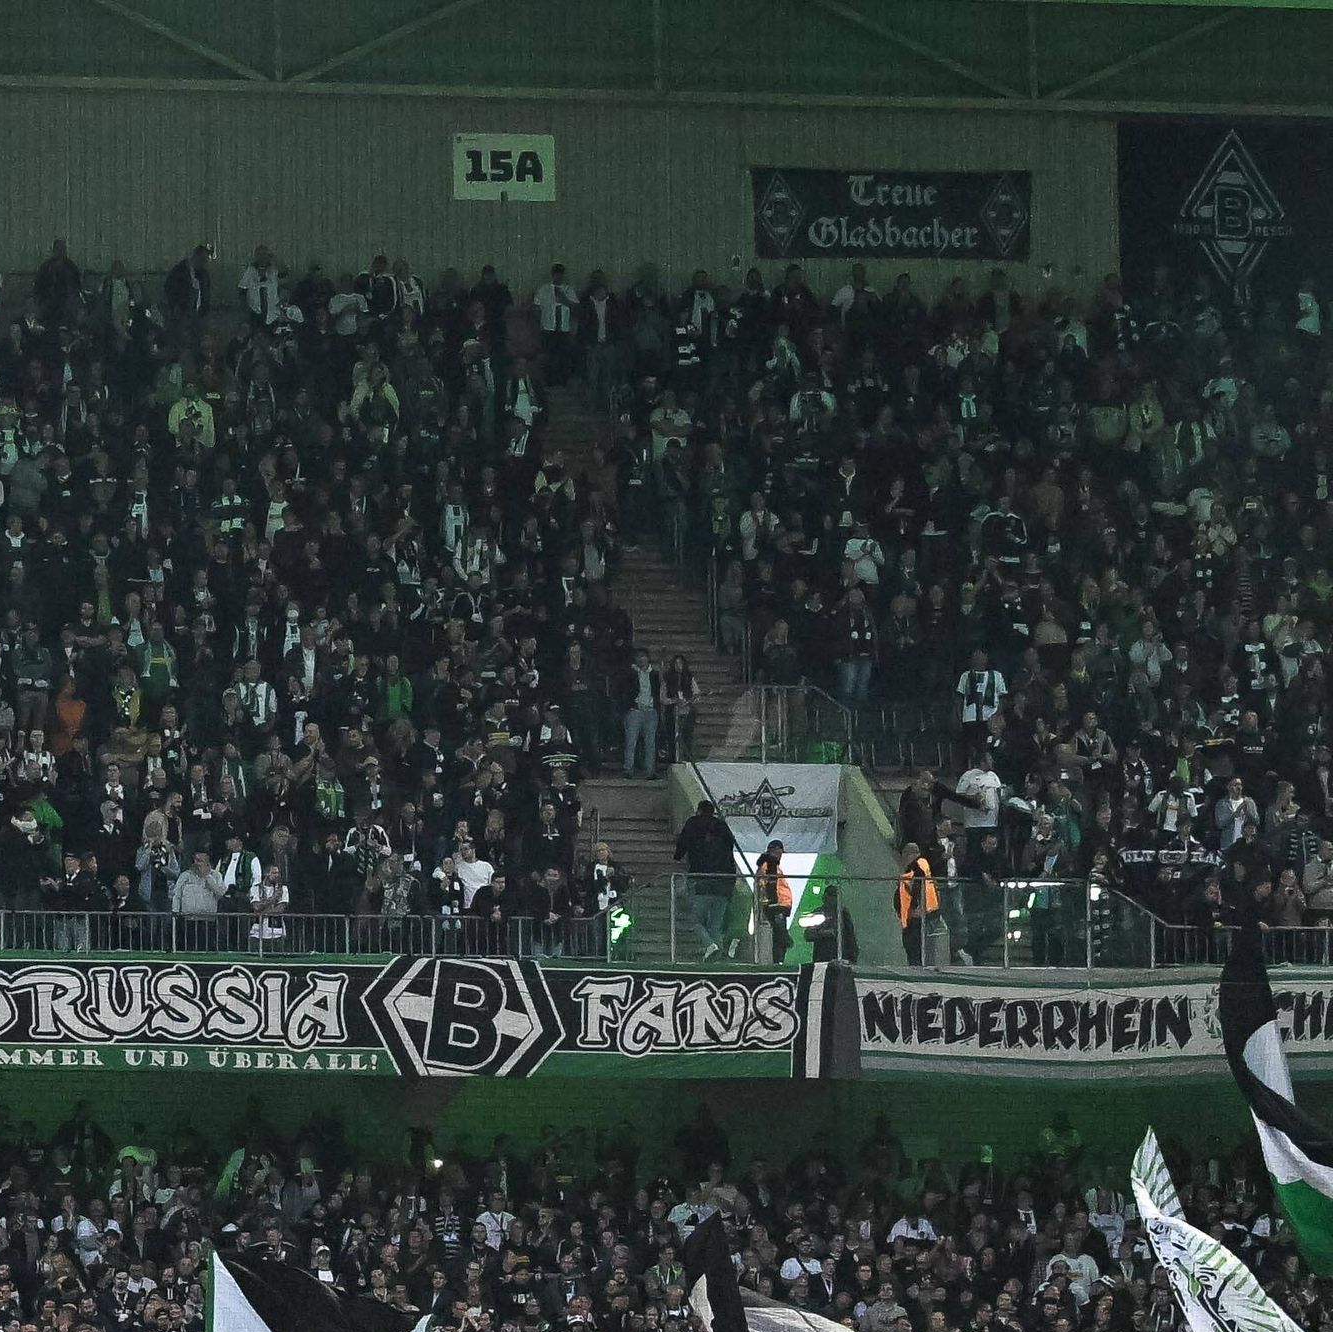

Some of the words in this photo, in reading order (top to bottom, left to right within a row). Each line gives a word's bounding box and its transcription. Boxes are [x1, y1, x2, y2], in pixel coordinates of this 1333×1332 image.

[465, 149, 544, 184] 15A
[848, 174, 938, 207] Treue
[808, 218, 980, 251] Gladbacher
[572, 976, 798, 1058] FANS
[862, 989, 1193, 1053] NIEDERRHEIN
[125, 1050, 189, 1068] UND
[210, 1046, 378, 1071] ÜBERALL!
